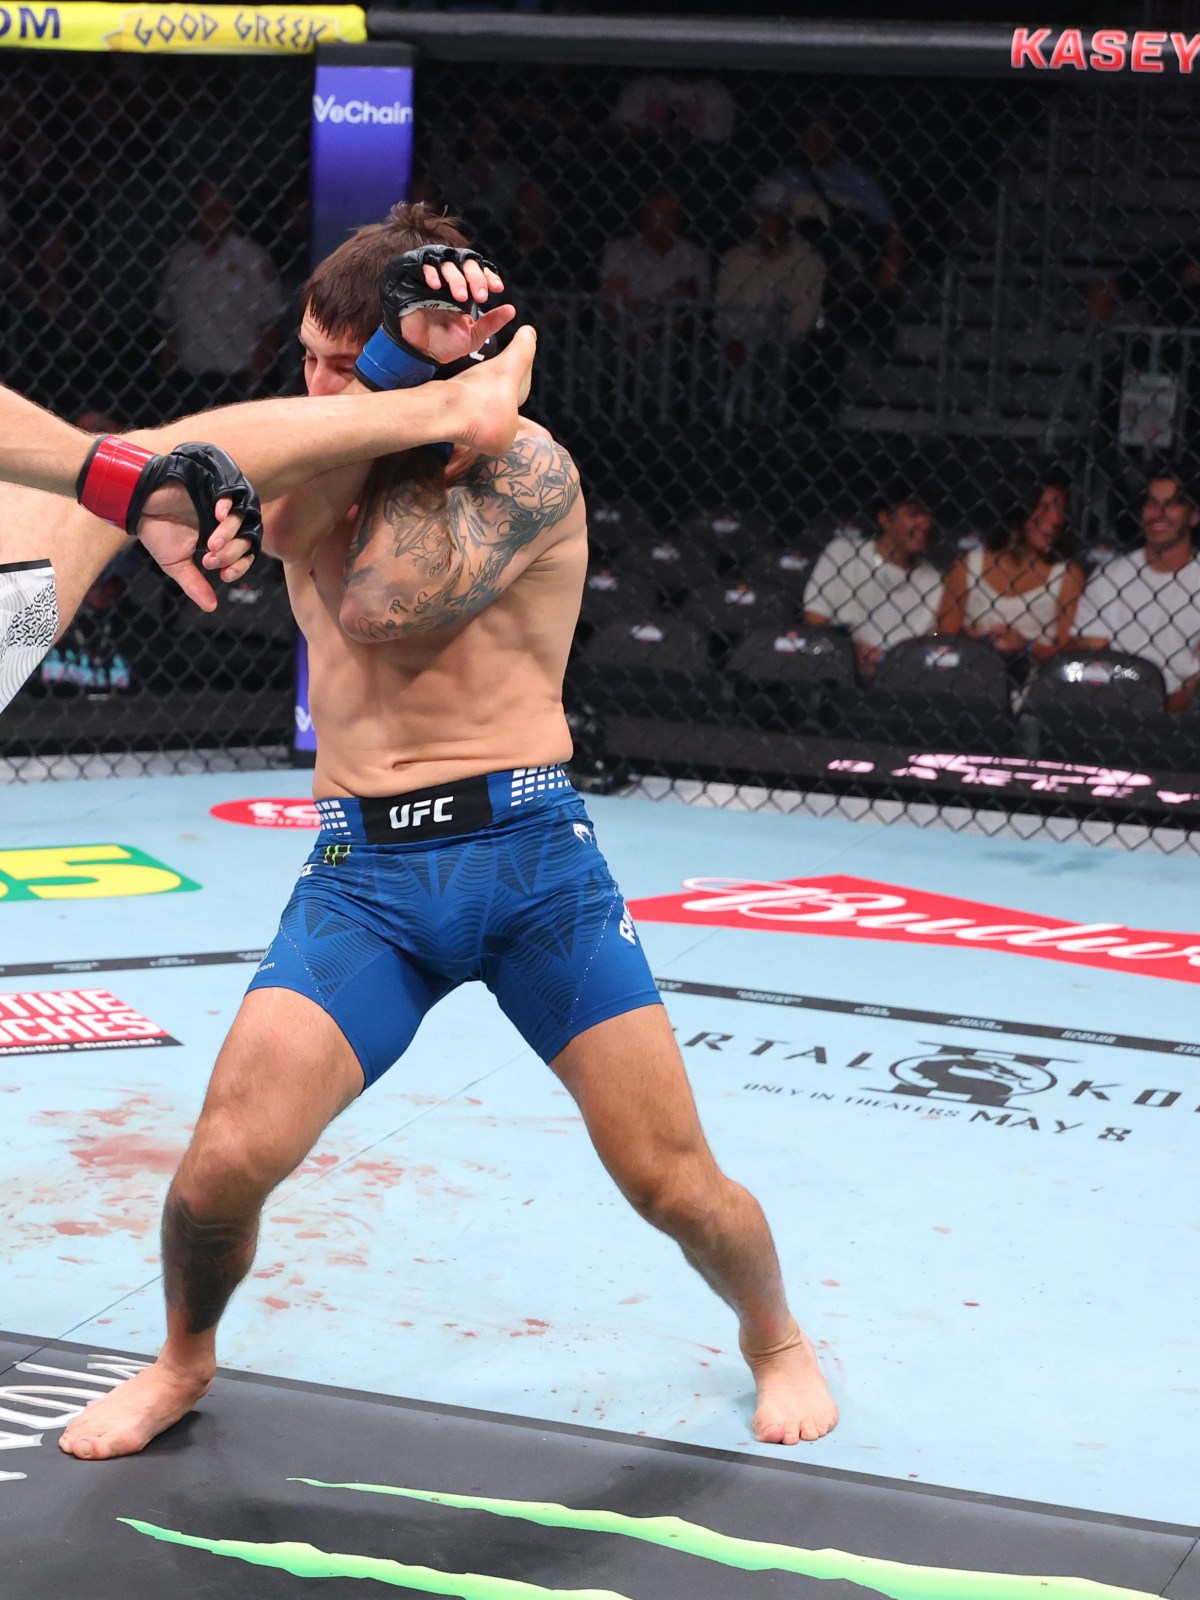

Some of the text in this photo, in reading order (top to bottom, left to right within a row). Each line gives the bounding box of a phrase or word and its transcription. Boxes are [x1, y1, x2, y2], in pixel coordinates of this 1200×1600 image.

[135, 12, 326, 48] GOOD GREEK
[1011, 27, 1200, 73] KASEY
[313, 94, 413, 124] VeChain
[390, 796, 455, 830] UFC
[681, 877, 1200, 967] Budw
[74, 1038, 162, 1051] chemical.
[672, 1028, 873, 1070] RTAL
[1069, 1080, 1200, 1113] KO
[743, 1083, 961, 1118] ONLY IN THEATERS
[969, 1110, 1132, 1142] MAY 8
